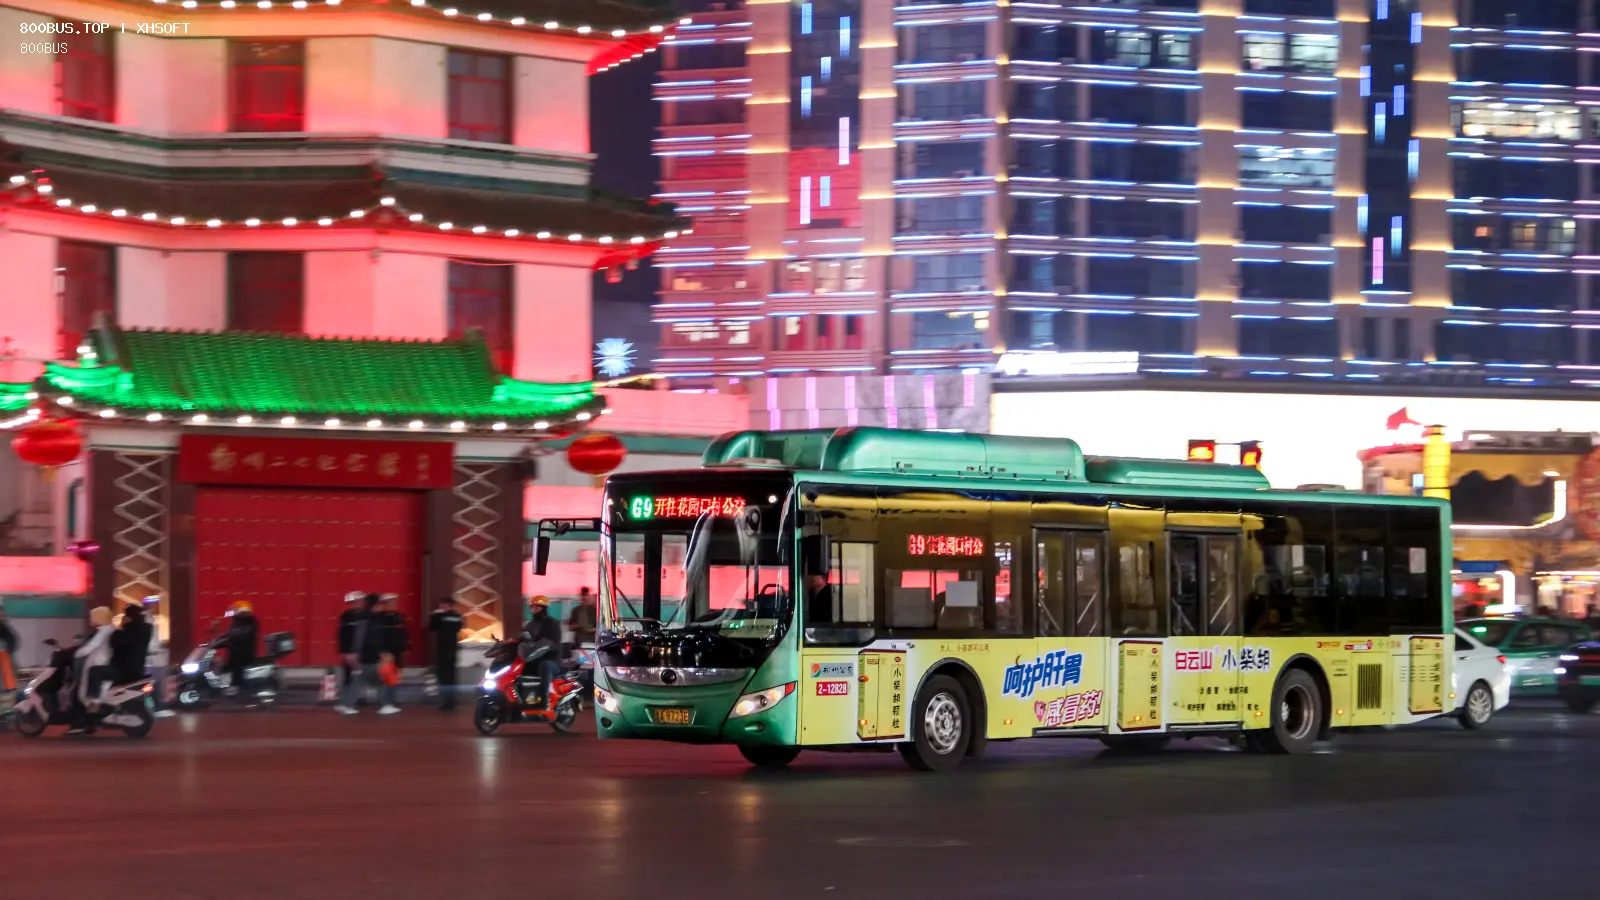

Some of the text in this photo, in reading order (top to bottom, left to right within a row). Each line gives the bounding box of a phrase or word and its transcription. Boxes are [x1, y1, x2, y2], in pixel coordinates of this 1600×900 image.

[632, 497, 652, 518] G9
[1175, 648, 1271, 671] 白云山 小柴胡
[1003, 651, 1082, 697] 呵护肝胃
[818, 683, 848, 695] 2-12828
